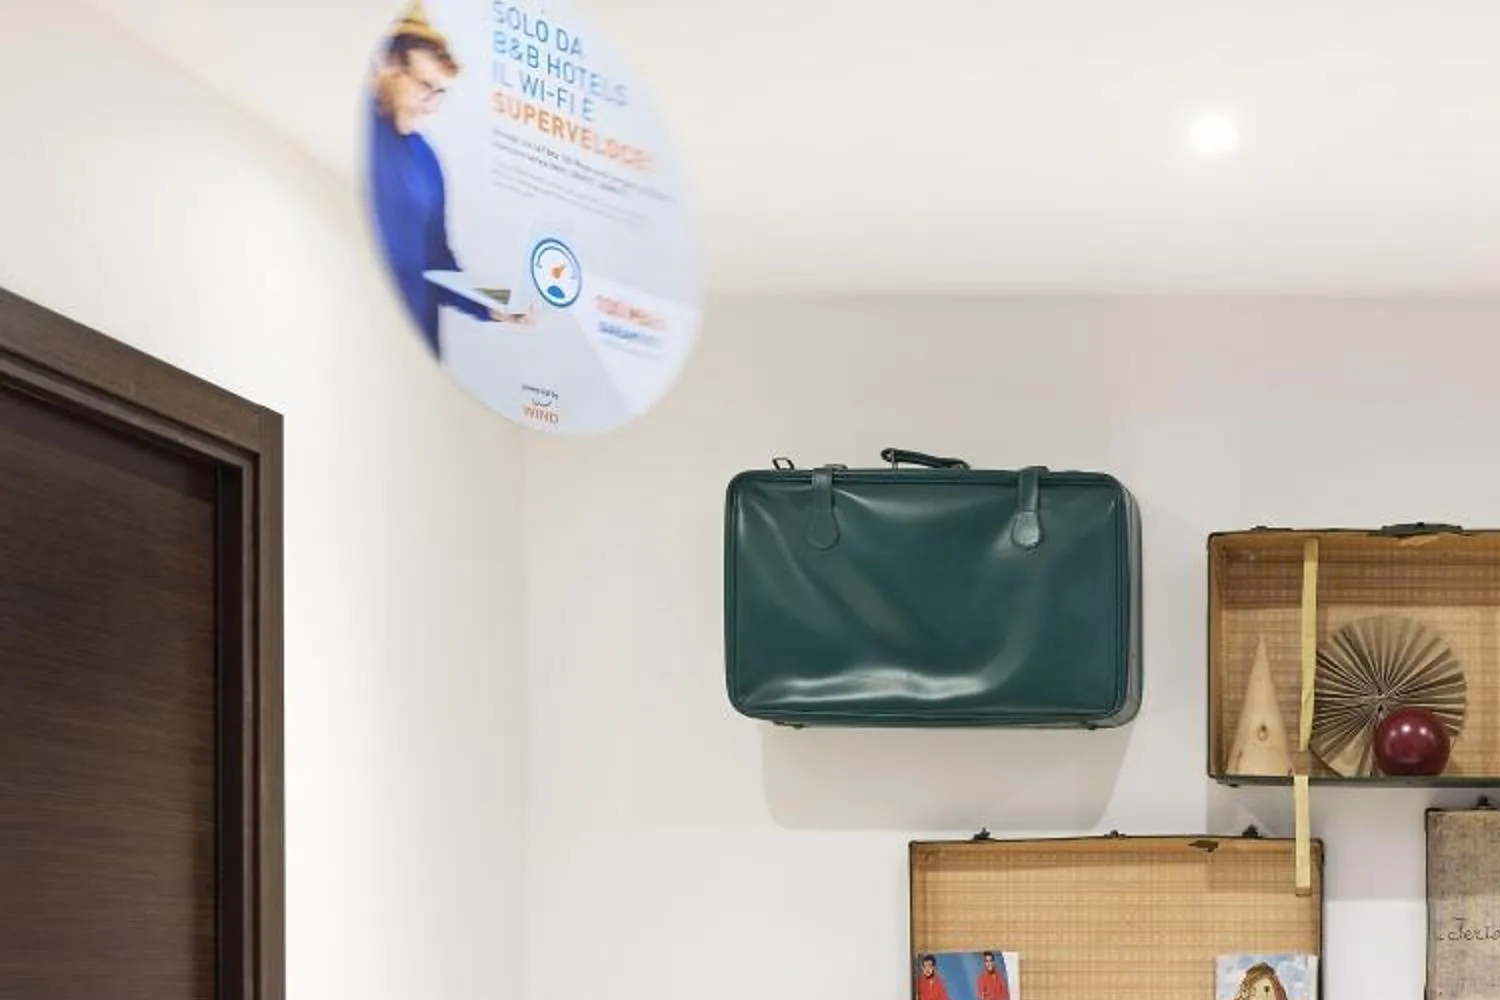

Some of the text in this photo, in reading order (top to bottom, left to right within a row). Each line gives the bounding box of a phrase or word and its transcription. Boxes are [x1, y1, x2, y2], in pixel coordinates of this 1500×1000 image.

[492, 0, 584, 56] SOLO DA
[493, 30, 628, 107] B&B HOTELS
[493, 61, 513, 88] IL
[520, 70, 575, 114] WI-FI
